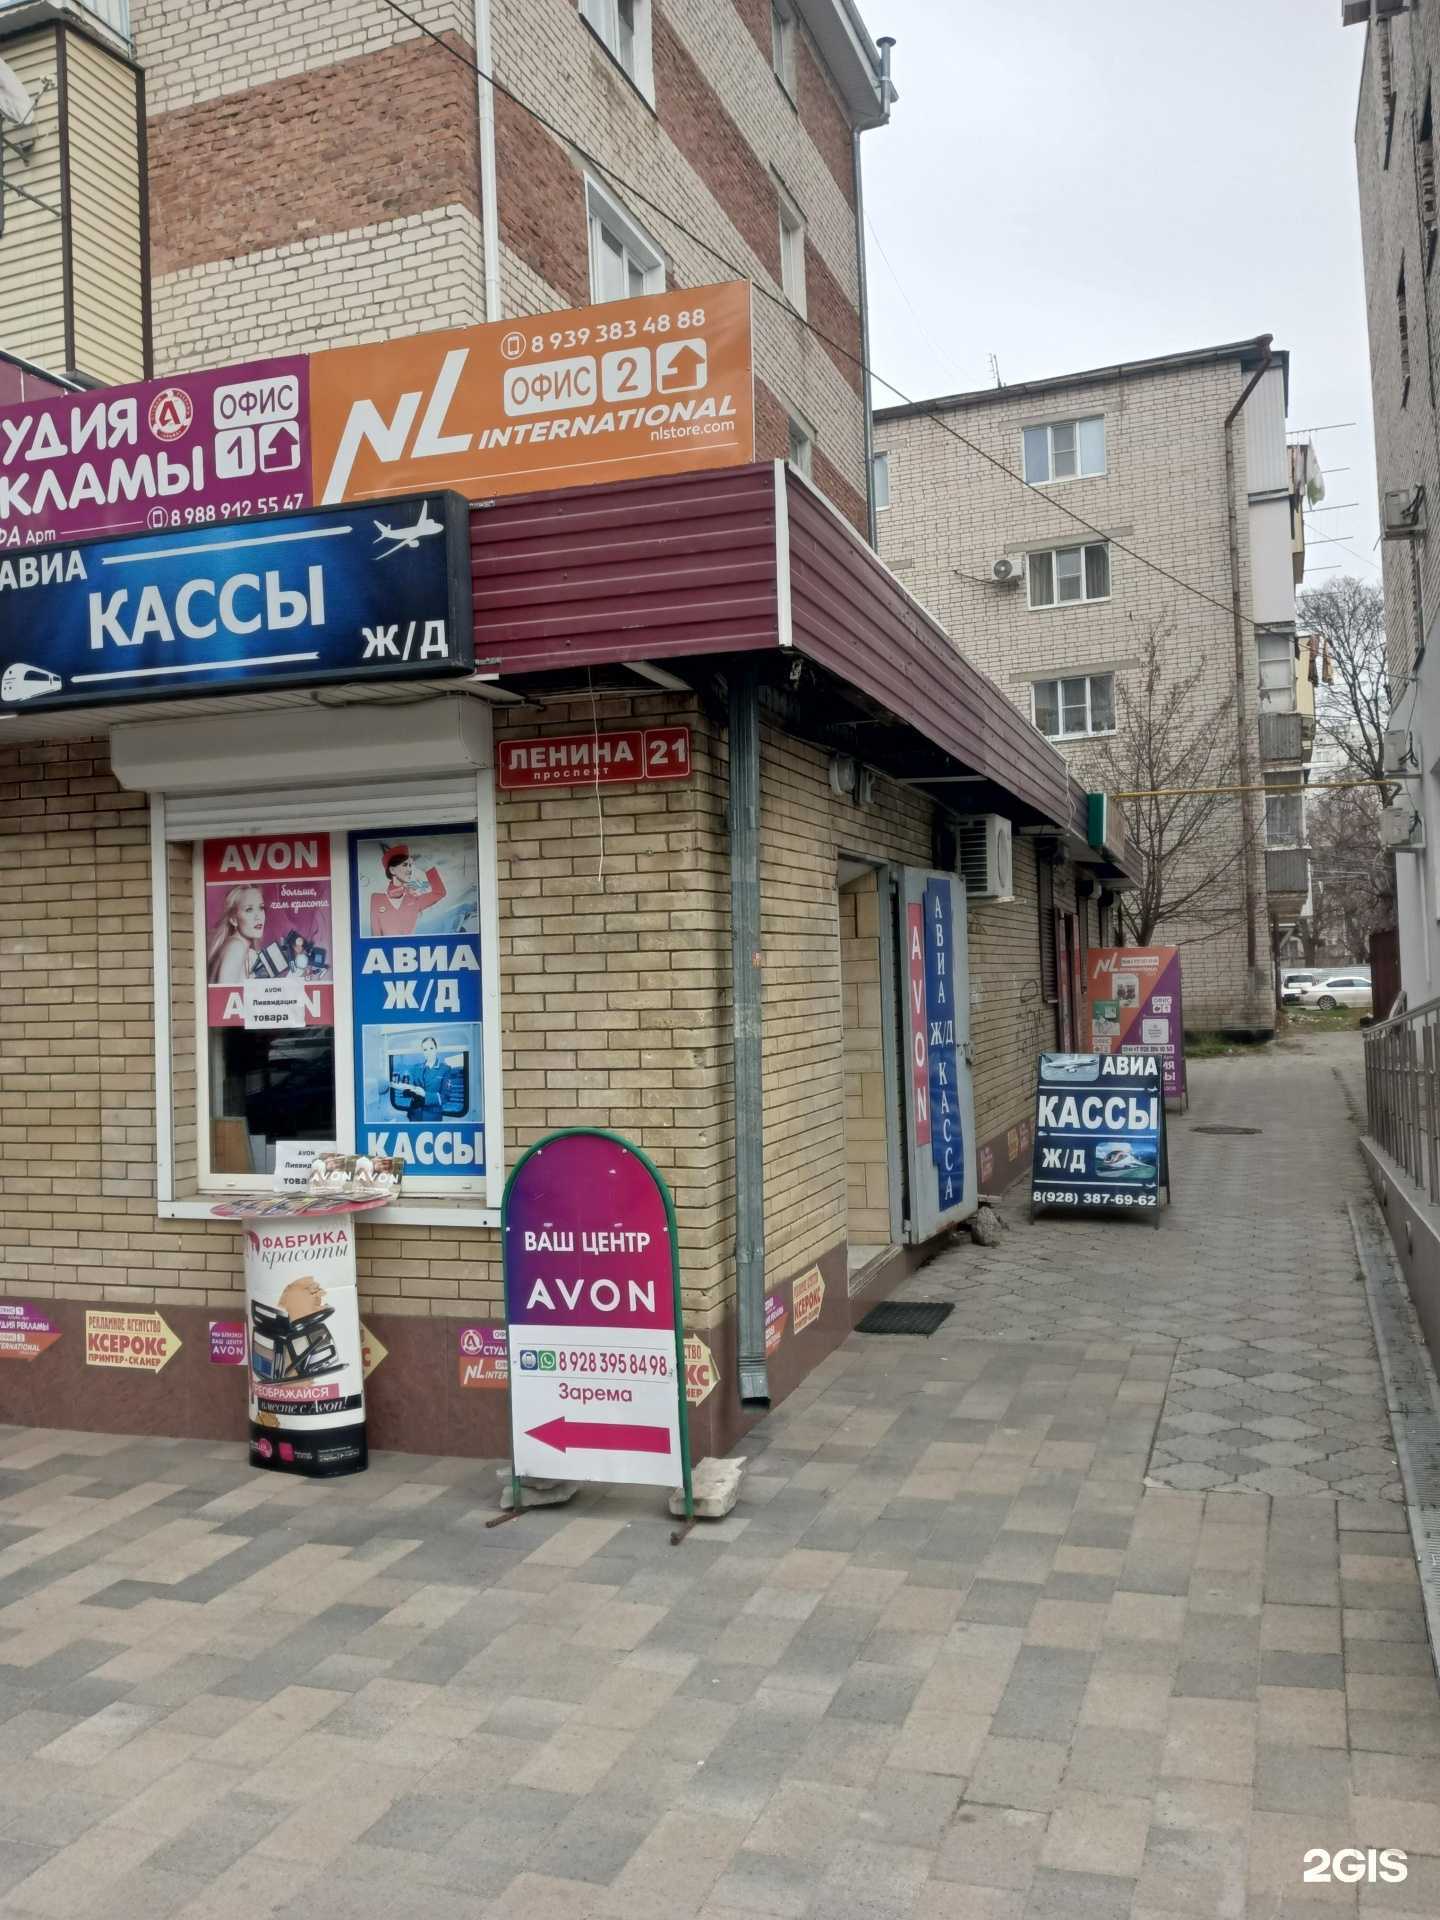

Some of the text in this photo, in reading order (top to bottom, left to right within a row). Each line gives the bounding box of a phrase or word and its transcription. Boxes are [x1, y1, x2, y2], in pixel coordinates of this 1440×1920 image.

[531, 308, 706, 353] 8 939 383 48 88
[511, 356, 639, 405] ОФИС 2
[220, 384, 293, 419] ОФИС
[321, 348, 475, 504] NL
[478, 395, 737, 450] INTERNATIONAL
[649, 418, 735, 441] nlstore.com
[227, 436, 243, 469] 1
[0, 446, 204, 519] КЛАМЫ
[171, 493, 304, 526] 8 988 912 55 47
[0, 550, 88, 591] АВИА
[88, 566, 325, 650] КАССЫ
[361, 620, 449, 660] Ж/Д
[509, 738, 686, 770] ЛЕНИНА 21
[534, 767, 609, 780] проспект
[220, 841, 318, 873] AVON
[362, 945, 480, 974] АВИА
[934, 895, 946, 1004] АВИА
[223, 991, 321, 1020] AN
[383, 979, 460, 1013] Ж/Д
[253, 1014, 289, 1023] товара
[912, 926, 927, 1123] AVON
[931, 1020, 953, 1048] Ж/Д
[1102, 1056, 1158, 1076] АВИА
[1038, 1095, 1158, 1130] КАССЫ
[938, 1062, 955, 1201] КАССА
[367, 1131, 483, 1166] КАССЫ
[1042, 1147, 1086, 1173] Ж/Д
[359, 1171, 400, 1184] AVON
[1033, 1191, 1156, 1206] 8(928) 387-69-62
[262, 1230, 347, 1249] ФАБРИКА
[525, 1232, 650, 1255] ВАШ ЦЕНТР
[262, 1244, 348, 1270] красоты
[526, 1278, 656, 1313] AVON
[88, 1333, 166, 1356] КСЕРОКС
[213, 1346, 243, 1355] AVON
[464, 1359, 484, 1384] NL
[558, 1383, 632, 1404] Зарема
